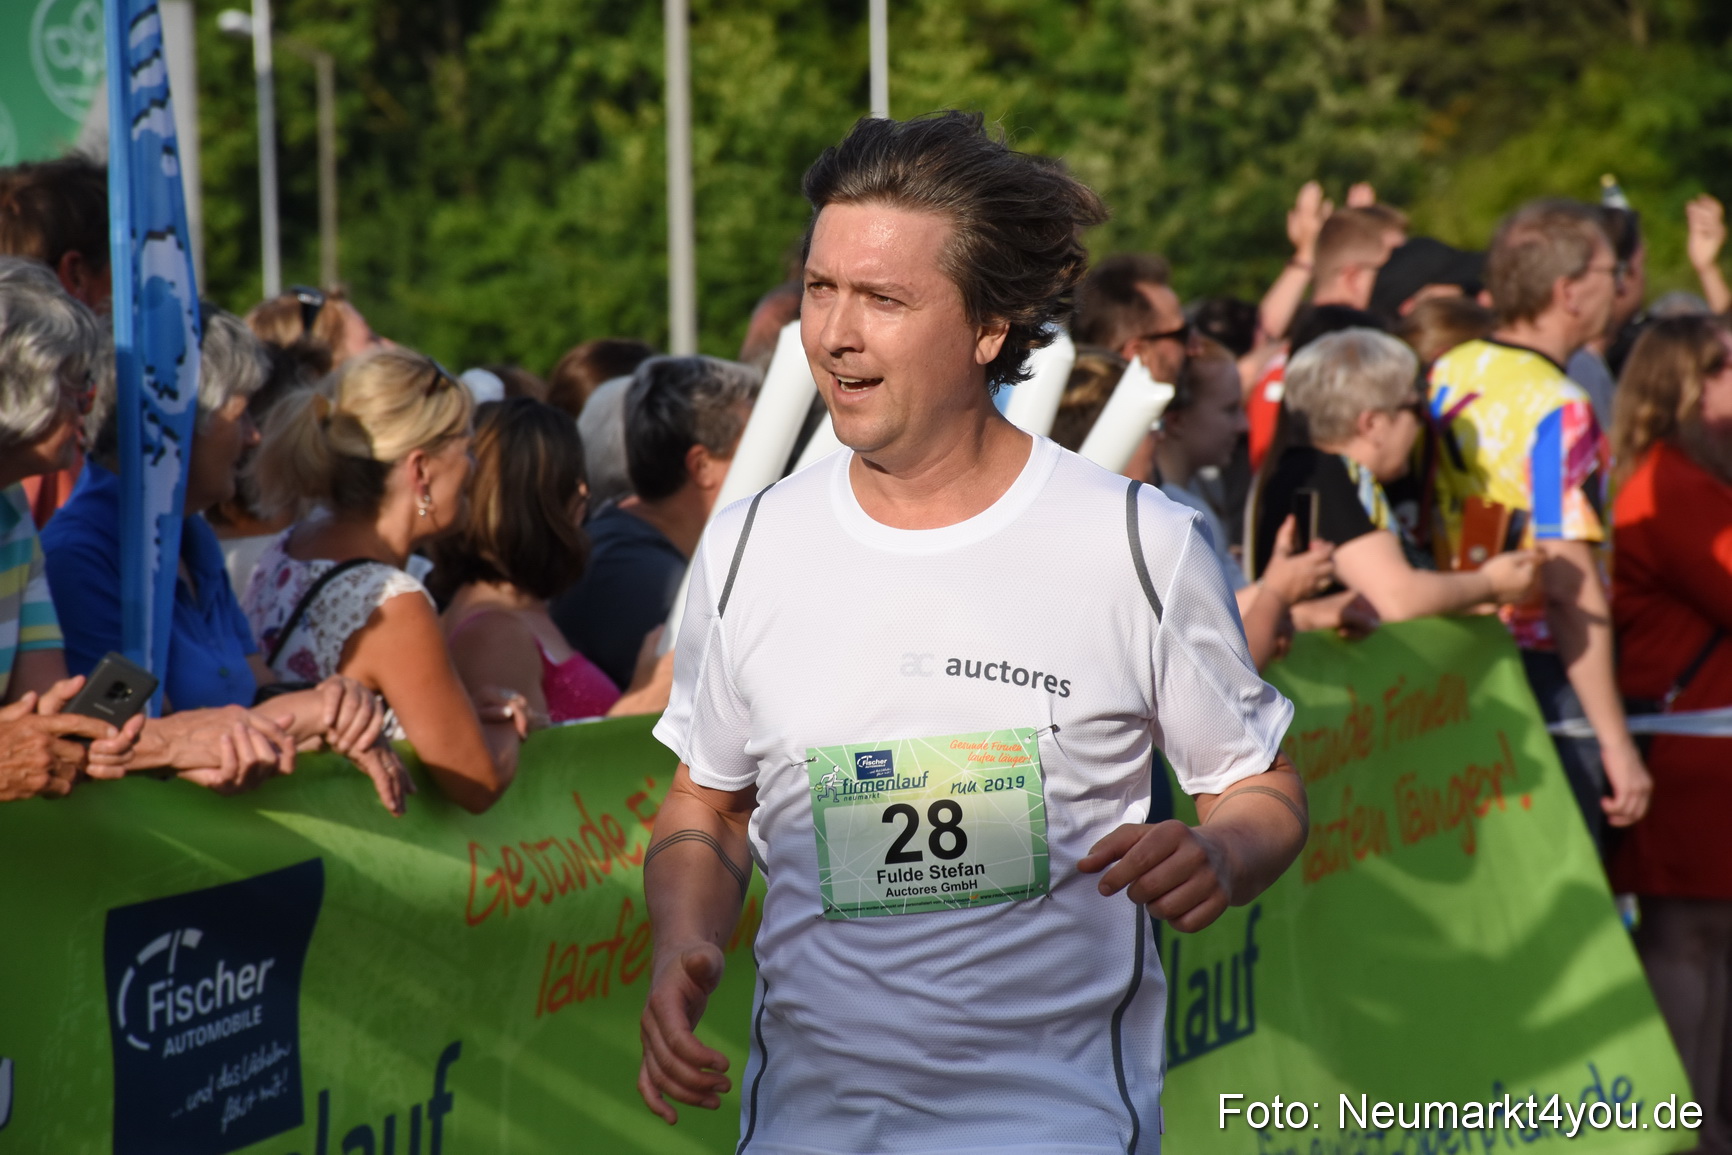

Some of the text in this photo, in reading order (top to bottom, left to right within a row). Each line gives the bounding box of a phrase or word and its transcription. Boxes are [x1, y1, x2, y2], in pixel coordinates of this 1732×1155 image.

[945, 657, 1072, 698] auctores
[949, 739, 1023, 752] Gesunde Firmen
[967, 751, 996, 764] laufen
[842, 770, 929, 794] firmenlauf
[984, 775, 1025, 793] 2019
[843, 792, 880, 801] neumarkt
[881, 798, 968, 865] 28
[464, 789, 645, 928] Gesunde
[876, 862, 986, 884] Fulde Stefan
[885, 879, 978, 898] Auctores GmbH
[535, 896, 654, 1020] laufe
[147, 957, 276, 1034] Fischer
[162, 1003, 264, 1060] AUTOMOBILE
